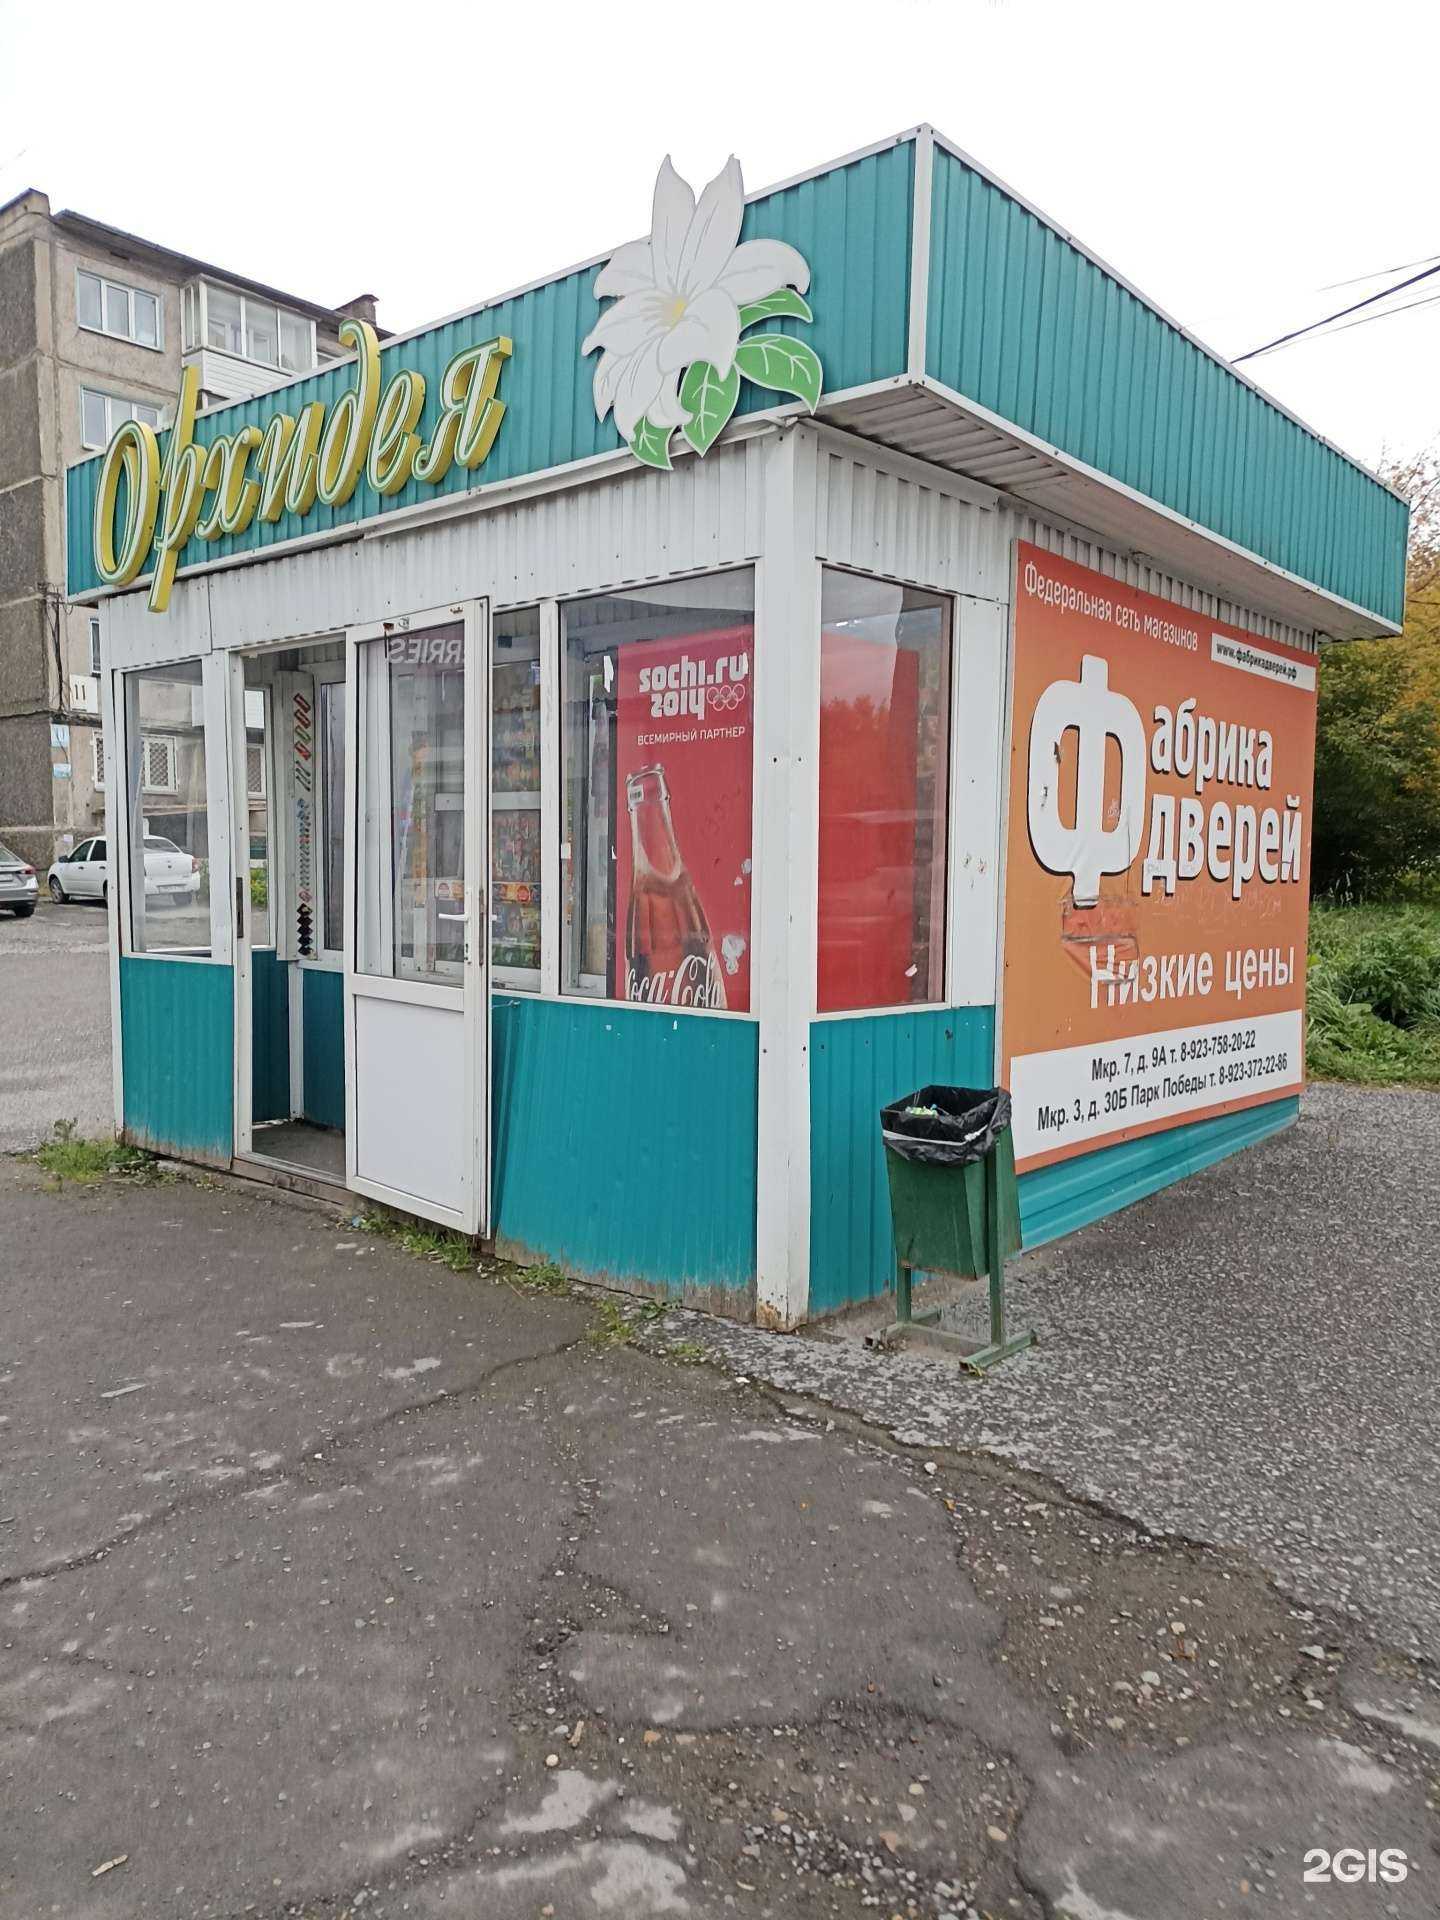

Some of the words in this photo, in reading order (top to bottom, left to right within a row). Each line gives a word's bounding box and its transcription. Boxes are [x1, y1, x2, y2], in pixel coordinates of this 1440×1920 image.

[93, 318, 513, 614] Орхидея
[1024, 561, 1112, 622] Федеральная
[1116, 602, 1141, 633] сеть
[1144, 615, 1198, 651] магазинов
[639, 652, 749, 693] sochi.ru
[650, 687, 705, 720] 2014
[637, 728, 697, 746] ВСЕМИРНЫЙ
[700, 726, 746, 741] ПАРТНЕР
[1027, 654, 1274, 909] Фабрика
[1089, 945, 1214, 1009] Низкие
[1225, 947, 1295, 1000] цены
[1091, 1057, 1121, 1083] Мкр.
[1124, 1052, 1134, 1076] 7,
[1136, 1054, 1149, 1075] д.
[1152, 1045, 1167, 1068] 9А
[1170, 1048, 1178, 1063] т.
[1180, 1030, 1256, 1062] 8-923-758-20-22
[1037, 1105, 1070, 1132] Мкр.
[1073, 1098, 1085, 1123] 3,
[1087, 1100, 1101, 1121] д.
[1104, 1087, 1128, 1114] 30Б
[1131, 1084, 1160, 1107] Парк
[1163, 1073, 1207, 1099] Победы
[1209, 1072, 1217, 1087] т.
